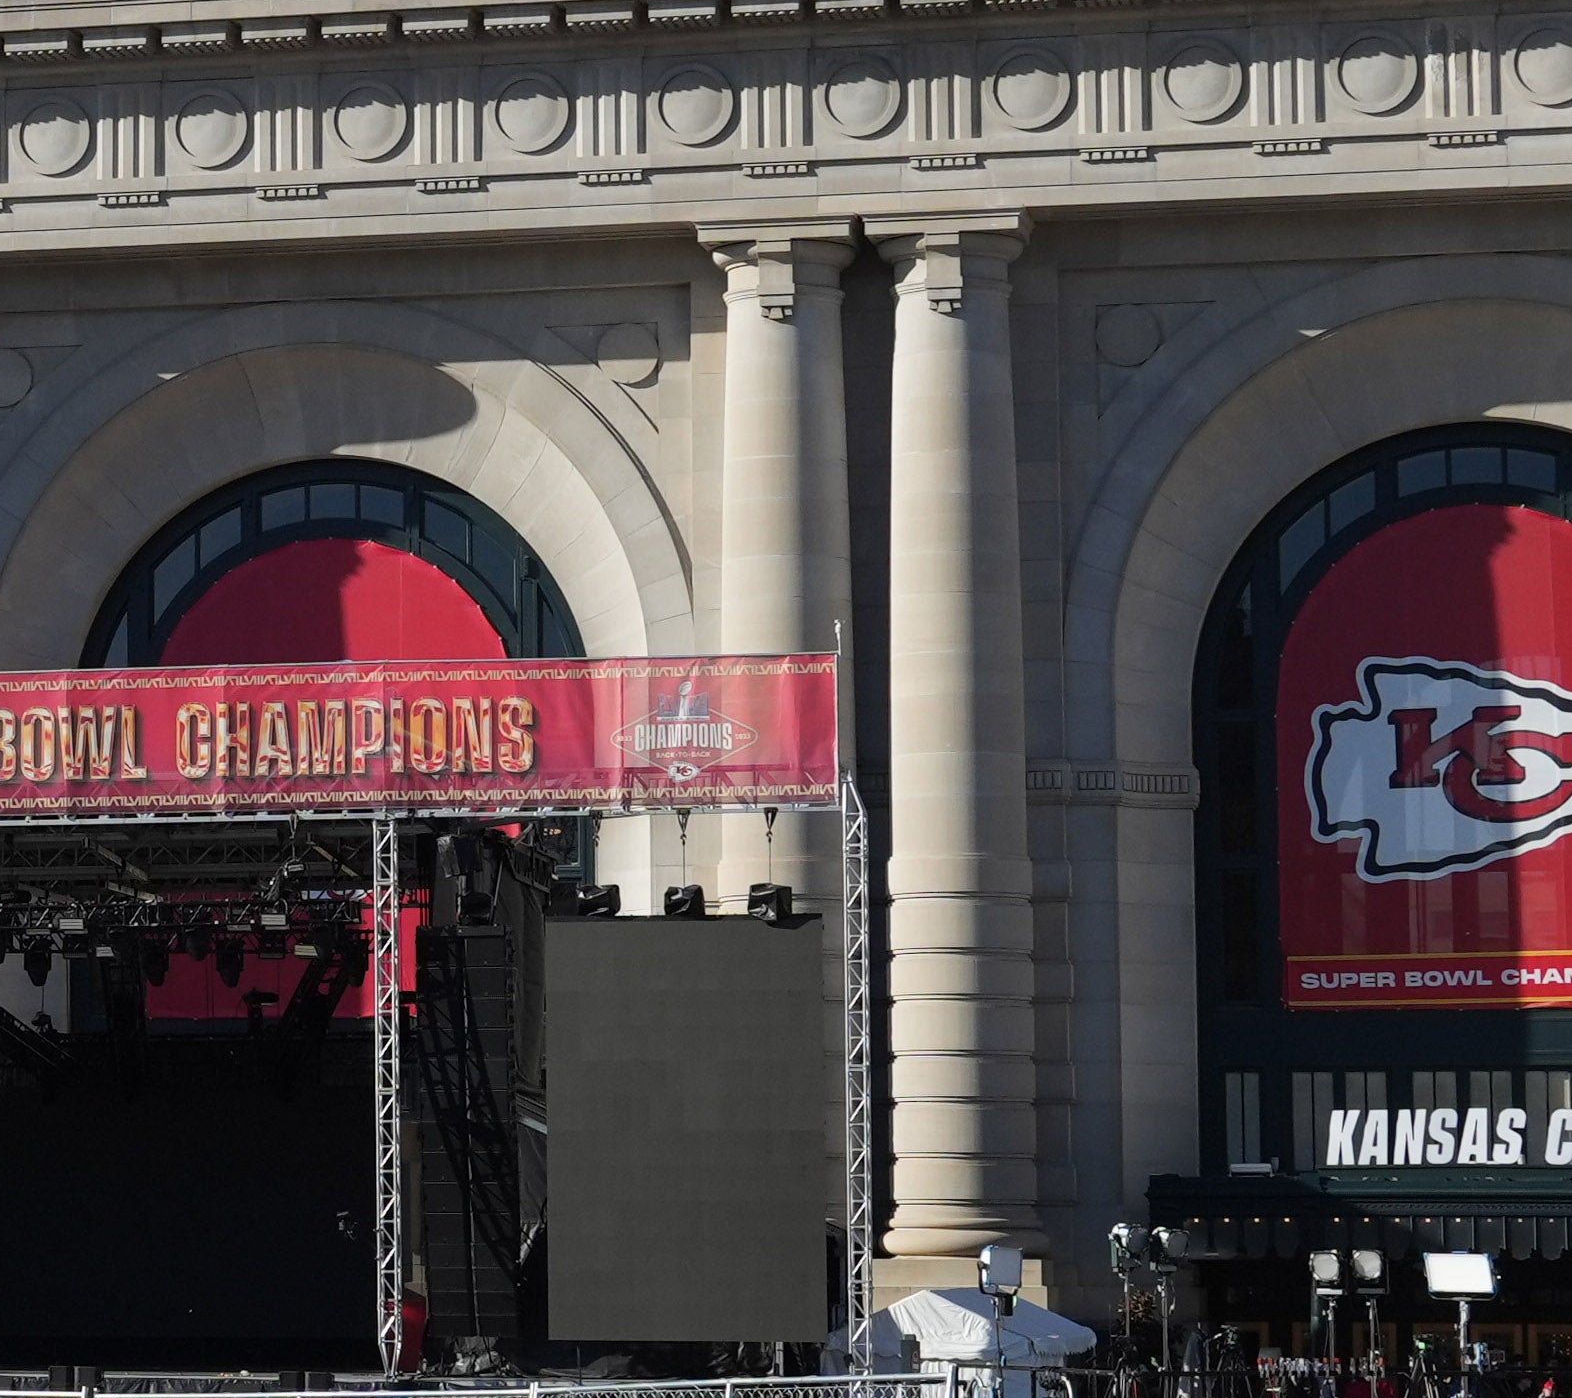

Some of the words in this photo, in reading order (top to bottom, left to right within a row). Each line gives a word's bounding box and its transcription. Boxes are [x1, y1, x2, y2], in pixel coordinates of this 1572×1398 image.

[176, 695, 535, 781] CHAMPIONS
[634, 722, 733, 752] CHAMPIONS
[1300, 970, 1396, 990] SUPER
[1405, 967, 1493, 988] BOWL
[1325, 1108, 1528, 1167] KANSAS
